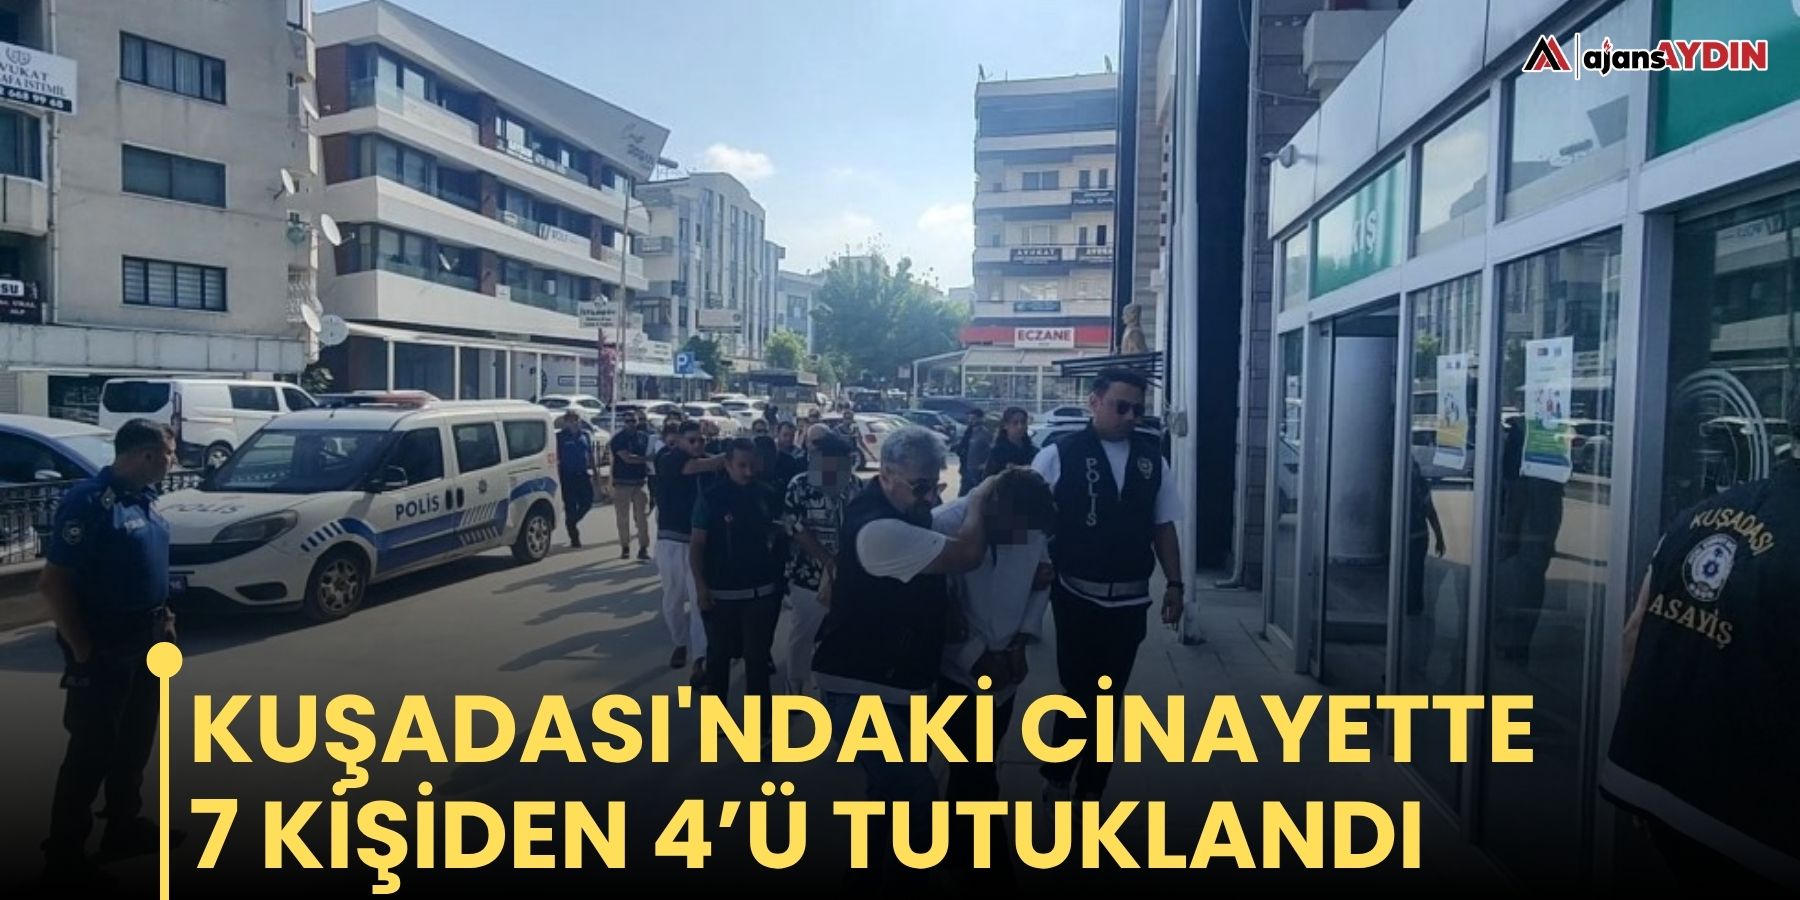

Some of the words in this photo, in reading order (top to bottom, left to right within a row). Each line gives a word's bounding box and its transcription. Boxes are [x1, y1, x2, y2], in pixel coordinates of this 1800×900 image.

[1017, 329, 1072, 341] ECZANE
[396, 493, 440, 520] POLİS
[1689, 508, 1775, 556] KUŞADASI
[1648, 593, 1733, 649] ASAYİŞ
